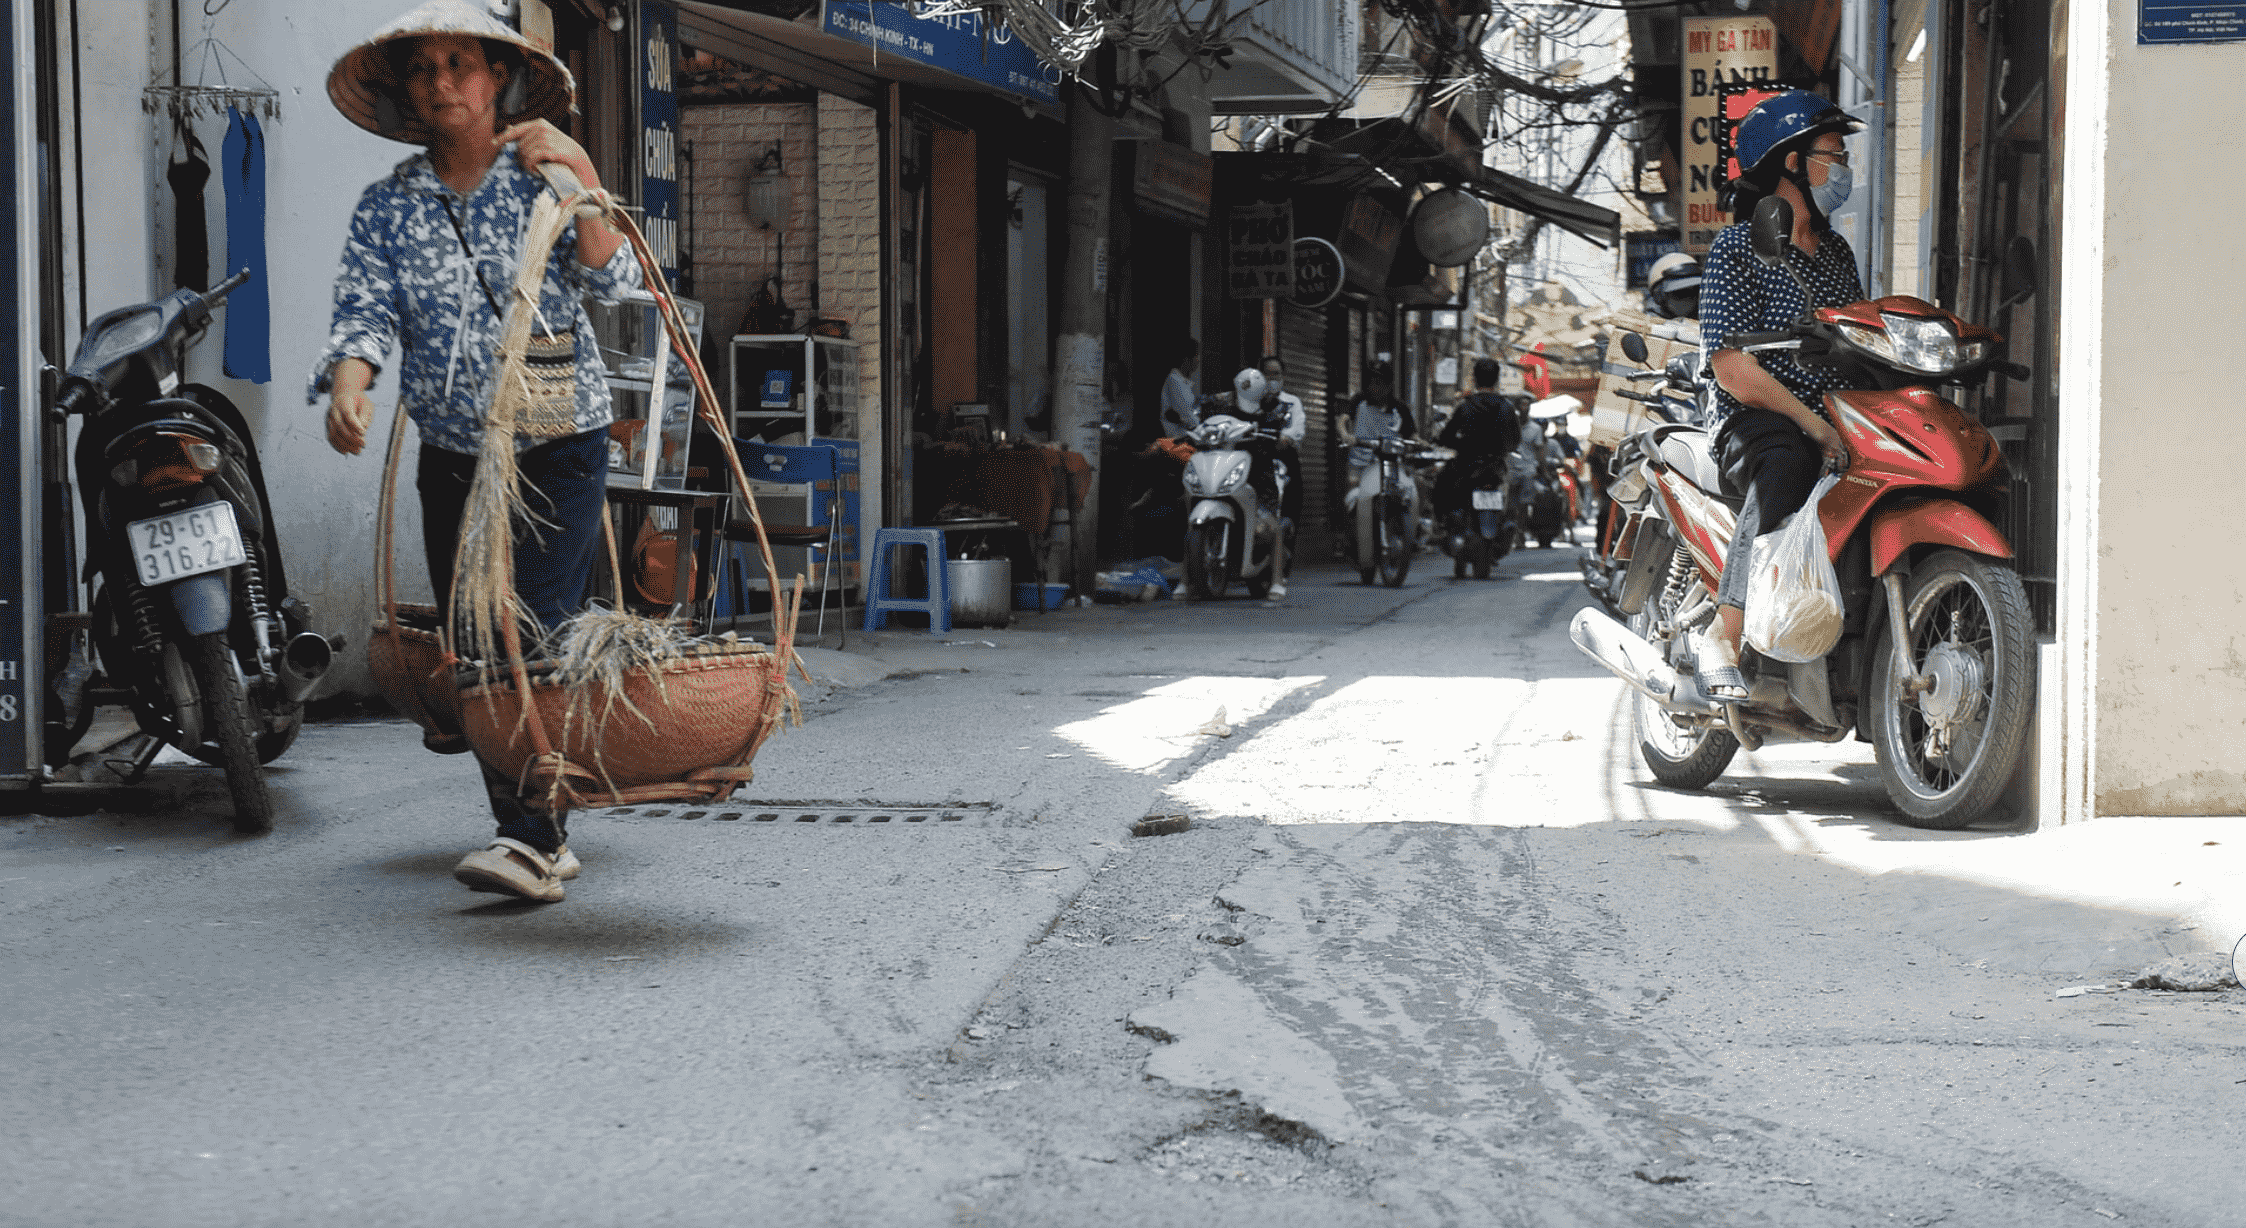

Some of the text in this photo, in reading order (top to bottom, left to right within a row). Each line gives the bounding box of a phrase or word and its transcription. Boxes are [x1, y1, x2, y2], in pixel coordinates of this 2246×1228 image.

[1847, 475, 1878, 488] HONDA
[144, 510, 218, 550] 29-G1
[143, 536, 236, 580] 316.22
